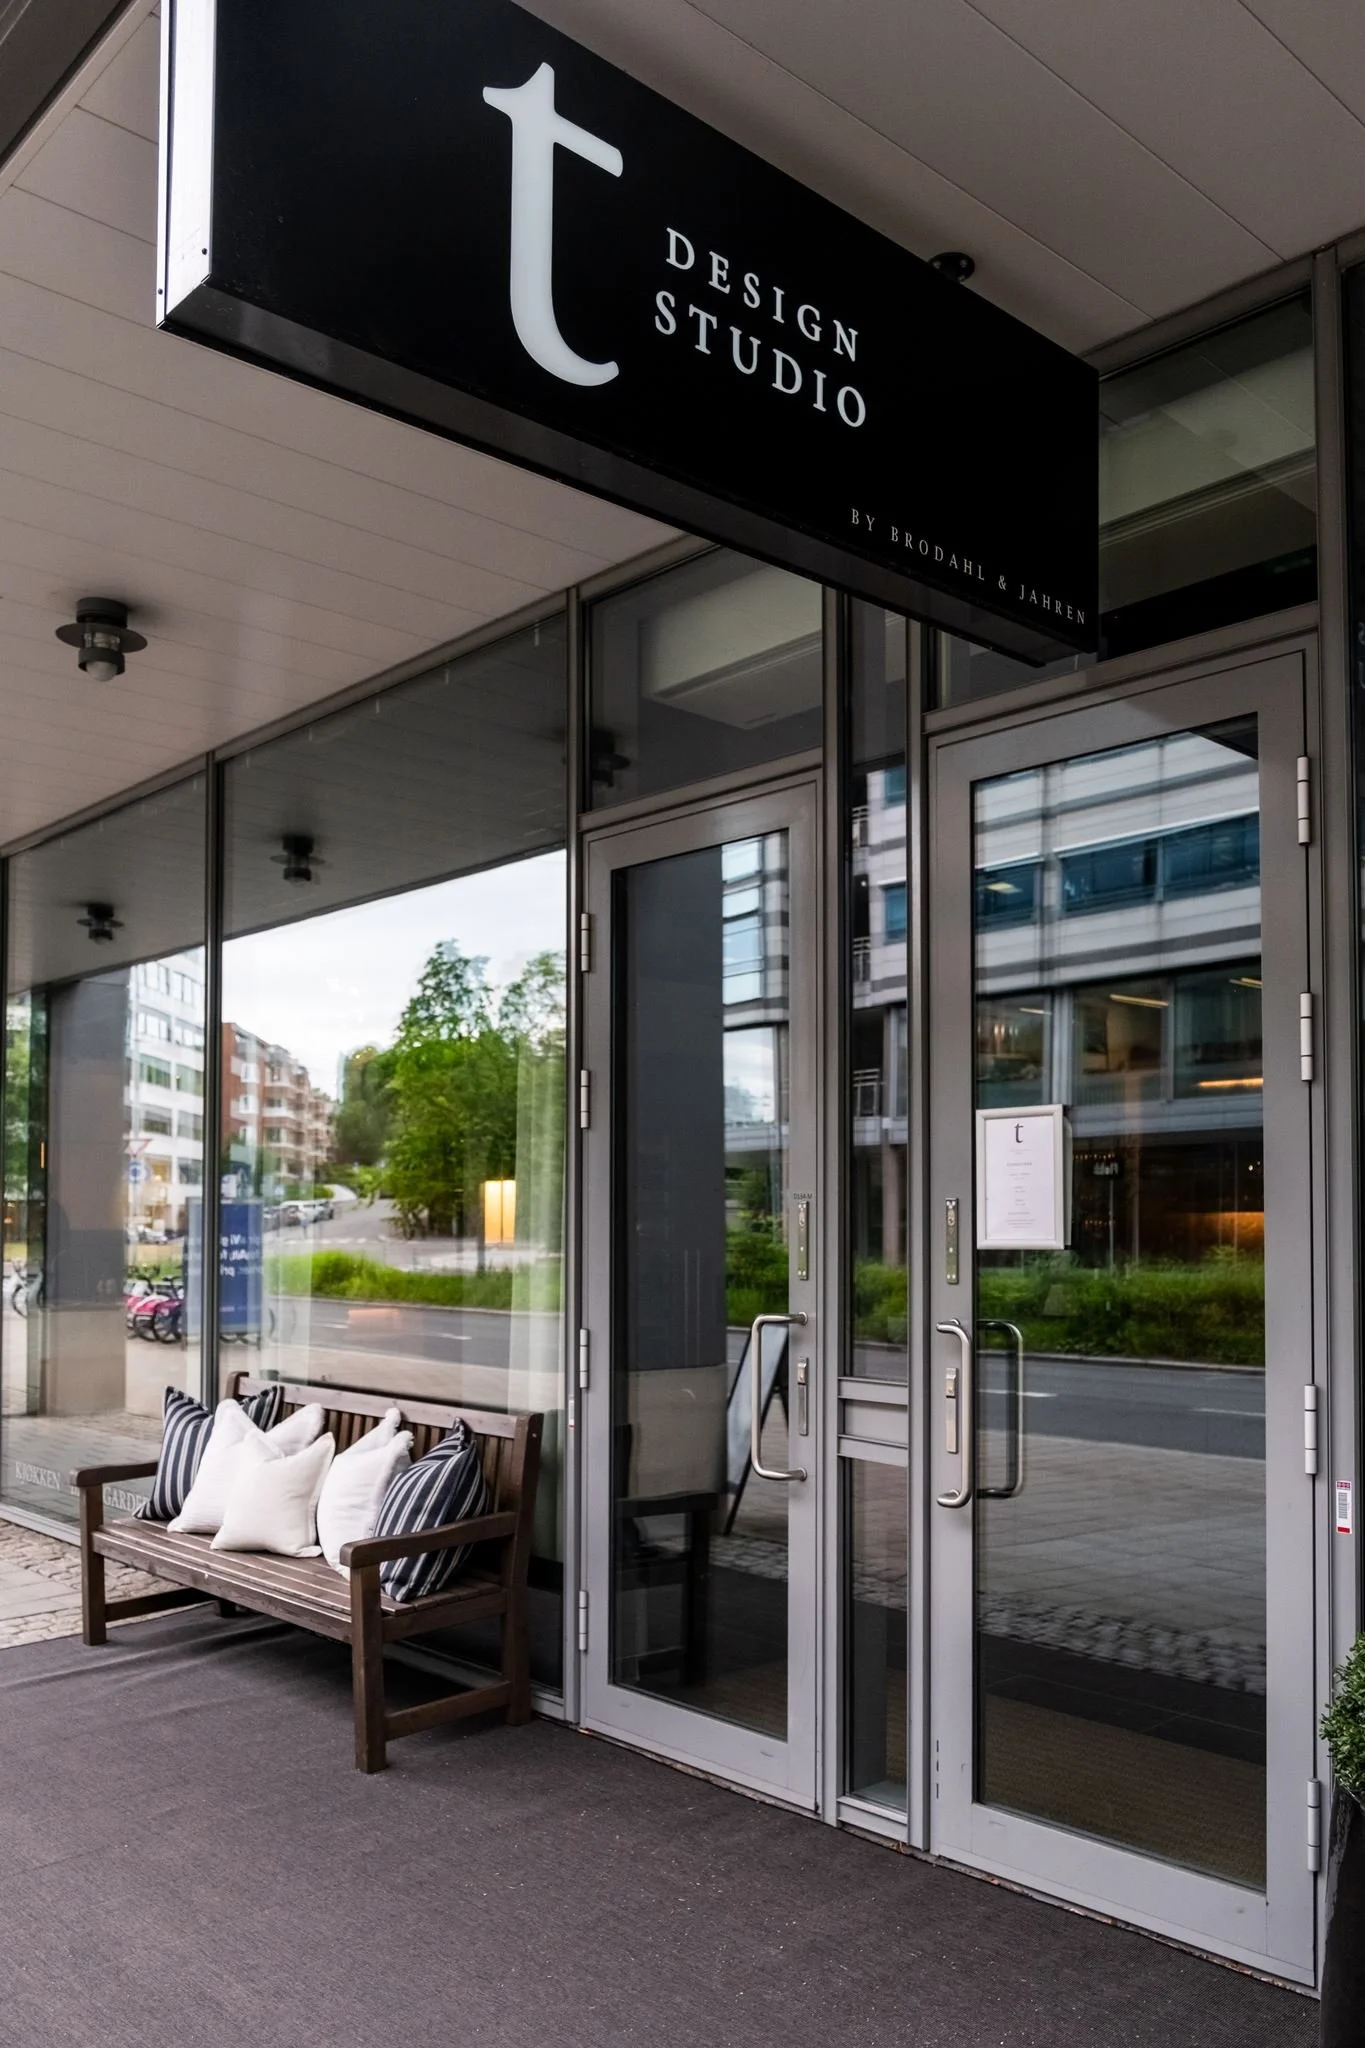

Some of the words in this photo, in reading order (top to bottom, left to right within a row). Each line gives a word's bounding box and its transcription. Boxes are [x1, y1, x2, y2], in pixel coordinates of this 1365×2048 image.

[482, 62, 624, 388] t
[653, 290, 868, 428] STUDIO
[665, 227, 859, 362] DESIGN
[851, 508, 876, 532] BY
[890, 525, 986, 581] BRODAHL
[997, 575, 1008, 591] &
[1018, 583, 1086, 625] JAHREN
[1013, 1122, 1025, 1144] t
